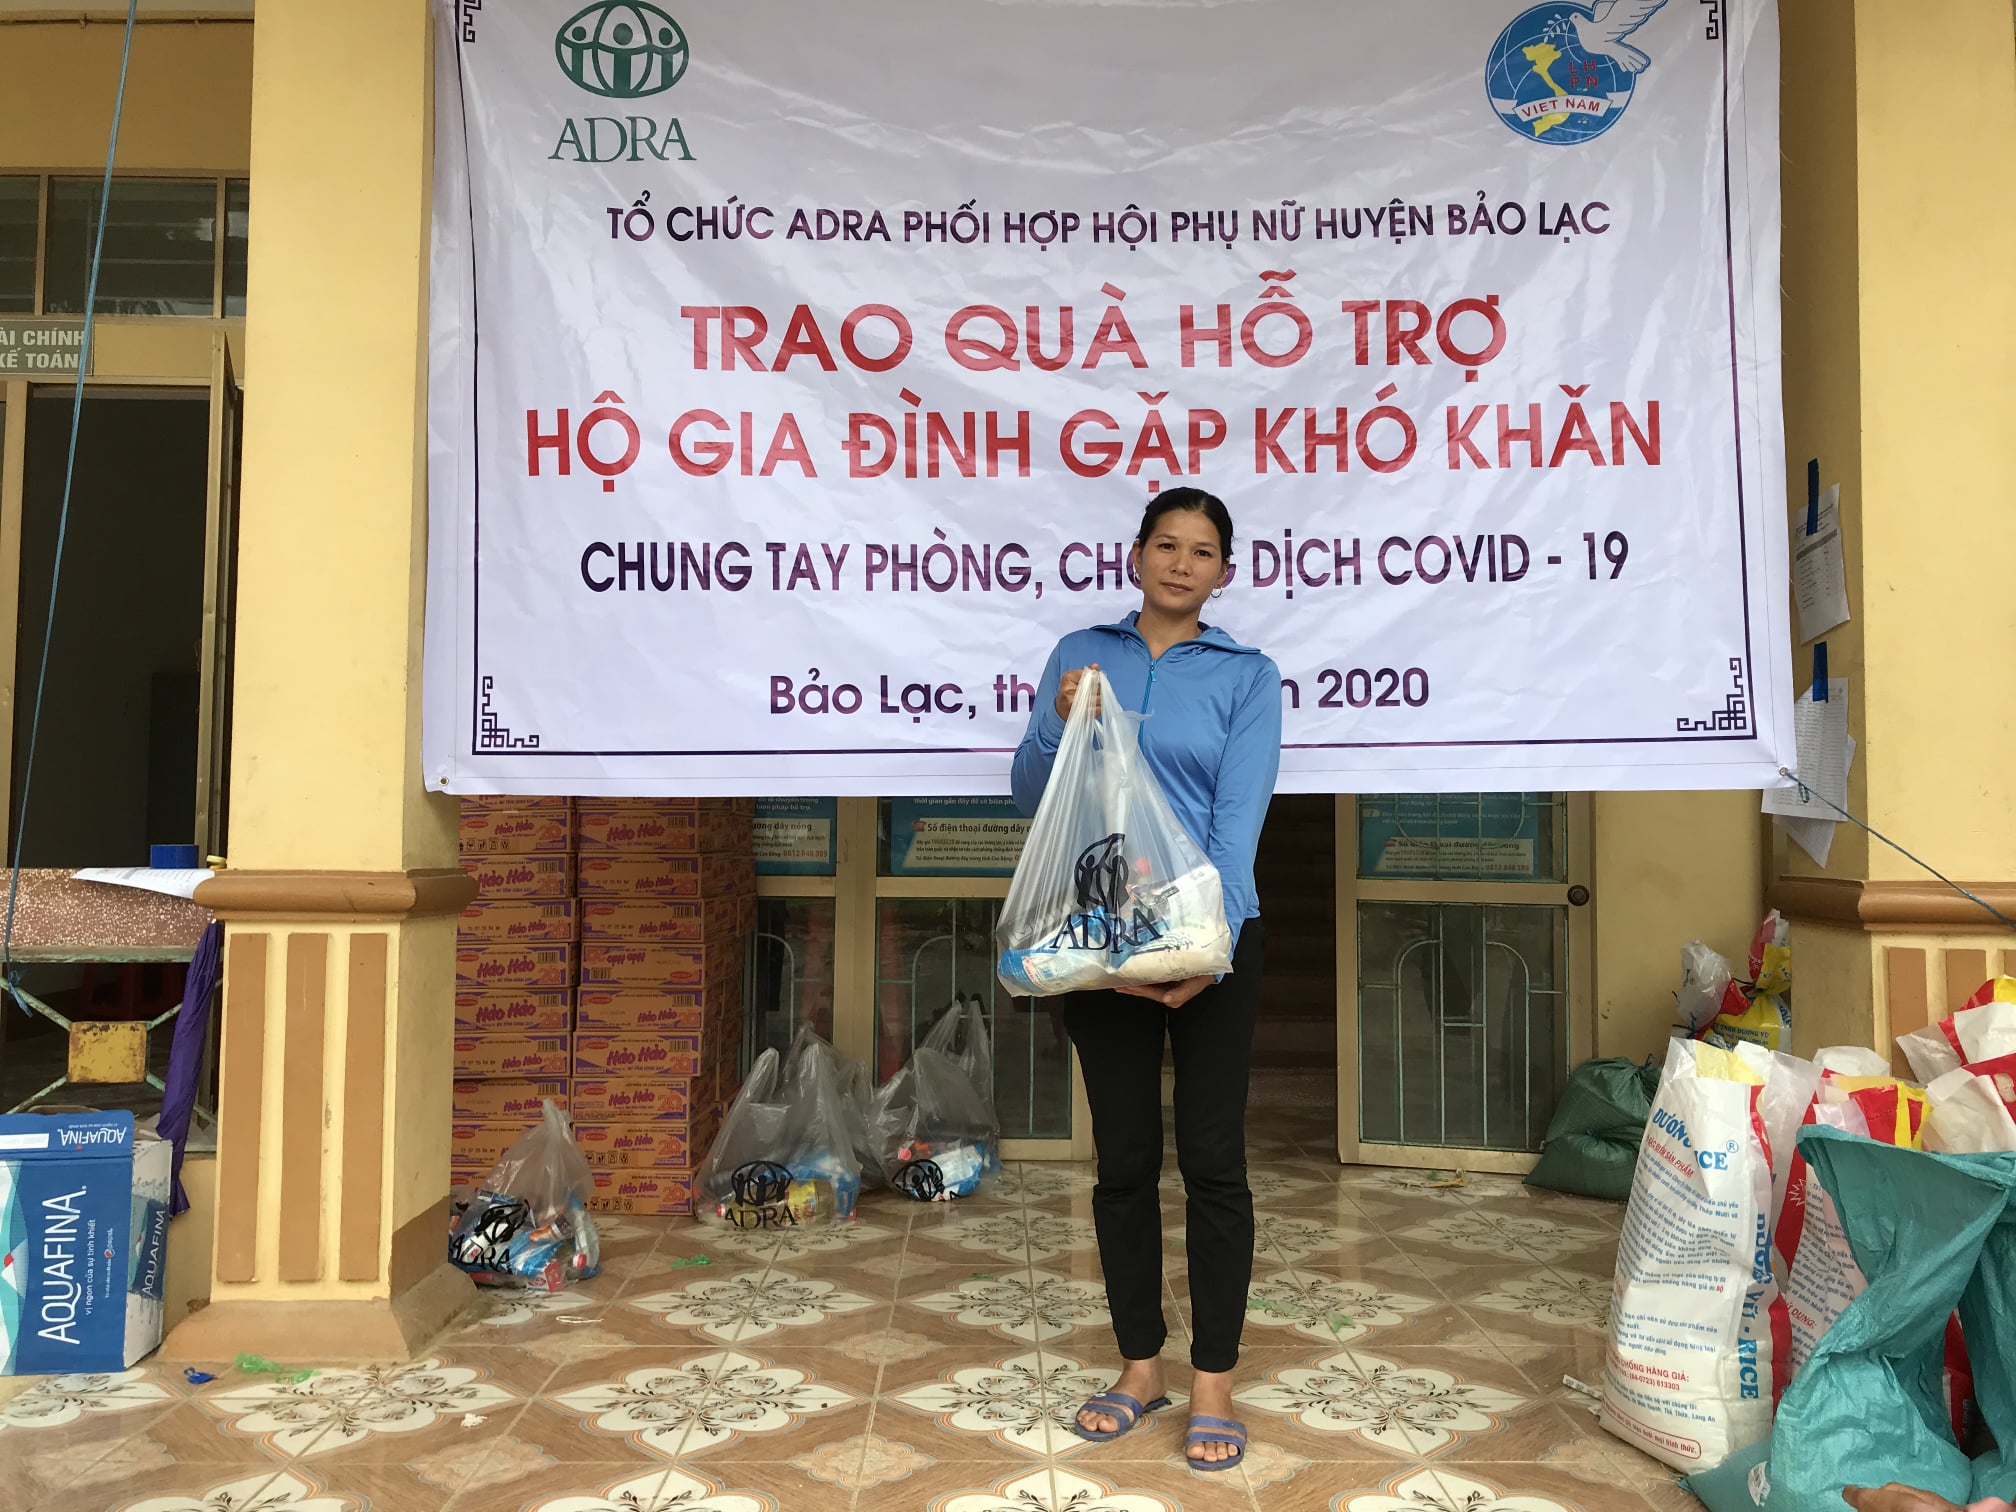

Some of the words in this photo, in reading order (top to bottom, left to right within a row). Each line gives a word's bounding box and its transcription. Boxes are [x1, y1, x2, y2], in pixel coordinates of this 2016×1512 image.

[1521, 99, 1558, 117] VIET
[1565, 98, 1600, 112] NAM
[549, 116, 696, 162] ADRA
[607, 190, 655, 241] TỔ
[667, 196, 774, 241] CHỨC
[786, 208, 890, 242] ADRA
[904, 199, 989, 243] PHỐI
[1004, 211, 1080, 251] HỢP
[1093, 204, 1157, 251] HỘI
[1171, 209, 1237, 250] PHỤ
[1252, 200, 1306, 242] NỮ
[1316, 198, 1434, 244] HUYỆN
[1448, 190, 1526, 237] BẢO
[1539, 201, 1611, 243] LẠC
[0, 327, 16, 346] ÀI
[23, 327, 85, 346] CHÍNH
[681, 303, 913, 372] TRAO
[945, 283, 1147, 372] QUÀ
[1179, 269, 1312, 368] HỖ
[1342, 294, 1506, 382] TRỢ
[25, 349, 79, 369] TOÁN
[527, 390, 641, 492] HỘ
[669, 409, 818, 479] GIA
[841, 388, 1031, 479] ĐÌNH
[1059, 391, 1227, 493] GẶP
[1254, 382, 1417, 474] KHÓ
[1447, 384, 1661, 471] KHĂN
[581, 541, 752, 592] CHUNG
[766, 543, 850, 591] TAY
[865, 527, 1043, 600] PHÒNG,
[1252, 528, 1361, 599] DỊCH
[1377, 534, 1530, 585] COVID
[1583, 531, 1629, 580] 19
[770, 668, 863, 714] Bảo
[880, 675, 977, 723] Lạc,
[1317, 666, 1429, 709] 2020
[927, 822, 938, 832] Số
[939, 823, 957, 835] điện
[958, 823, 981, 835] thoại
[982, 823, 1009, 835] đường
[478, 870, 504, 888] Hảo
[506, 866, 534, 885] Hảo
[1050, 907, 1164, 954] ADRA
[477, 959, 505, 978] Hảo
[507, 955, 535, 974] Hảo
[476, 1003, 505, 1023] Hảo
[507, 999, 536, 1018] Hảo
[607, 1047, 636, 1066] Hảo
[637, 1043, 667, 1062] Hảo
[1675, 1158, 1694, 1179] PHẨM
[724, 1206, 798, 1229] ADRA
[86, 1240, 95, 1256] tinh
[142, 1210, 166, 1297] AQUAFINA
[37, 1186, 87, 1345] AQUAFINA
[84, 1268, 94, 1283] của
[85, 1284, 94, 1306] ngon
[1646, 1364, 1669, 1379] HÀNG
[1738, 1338, 1759, 1399] RICE
